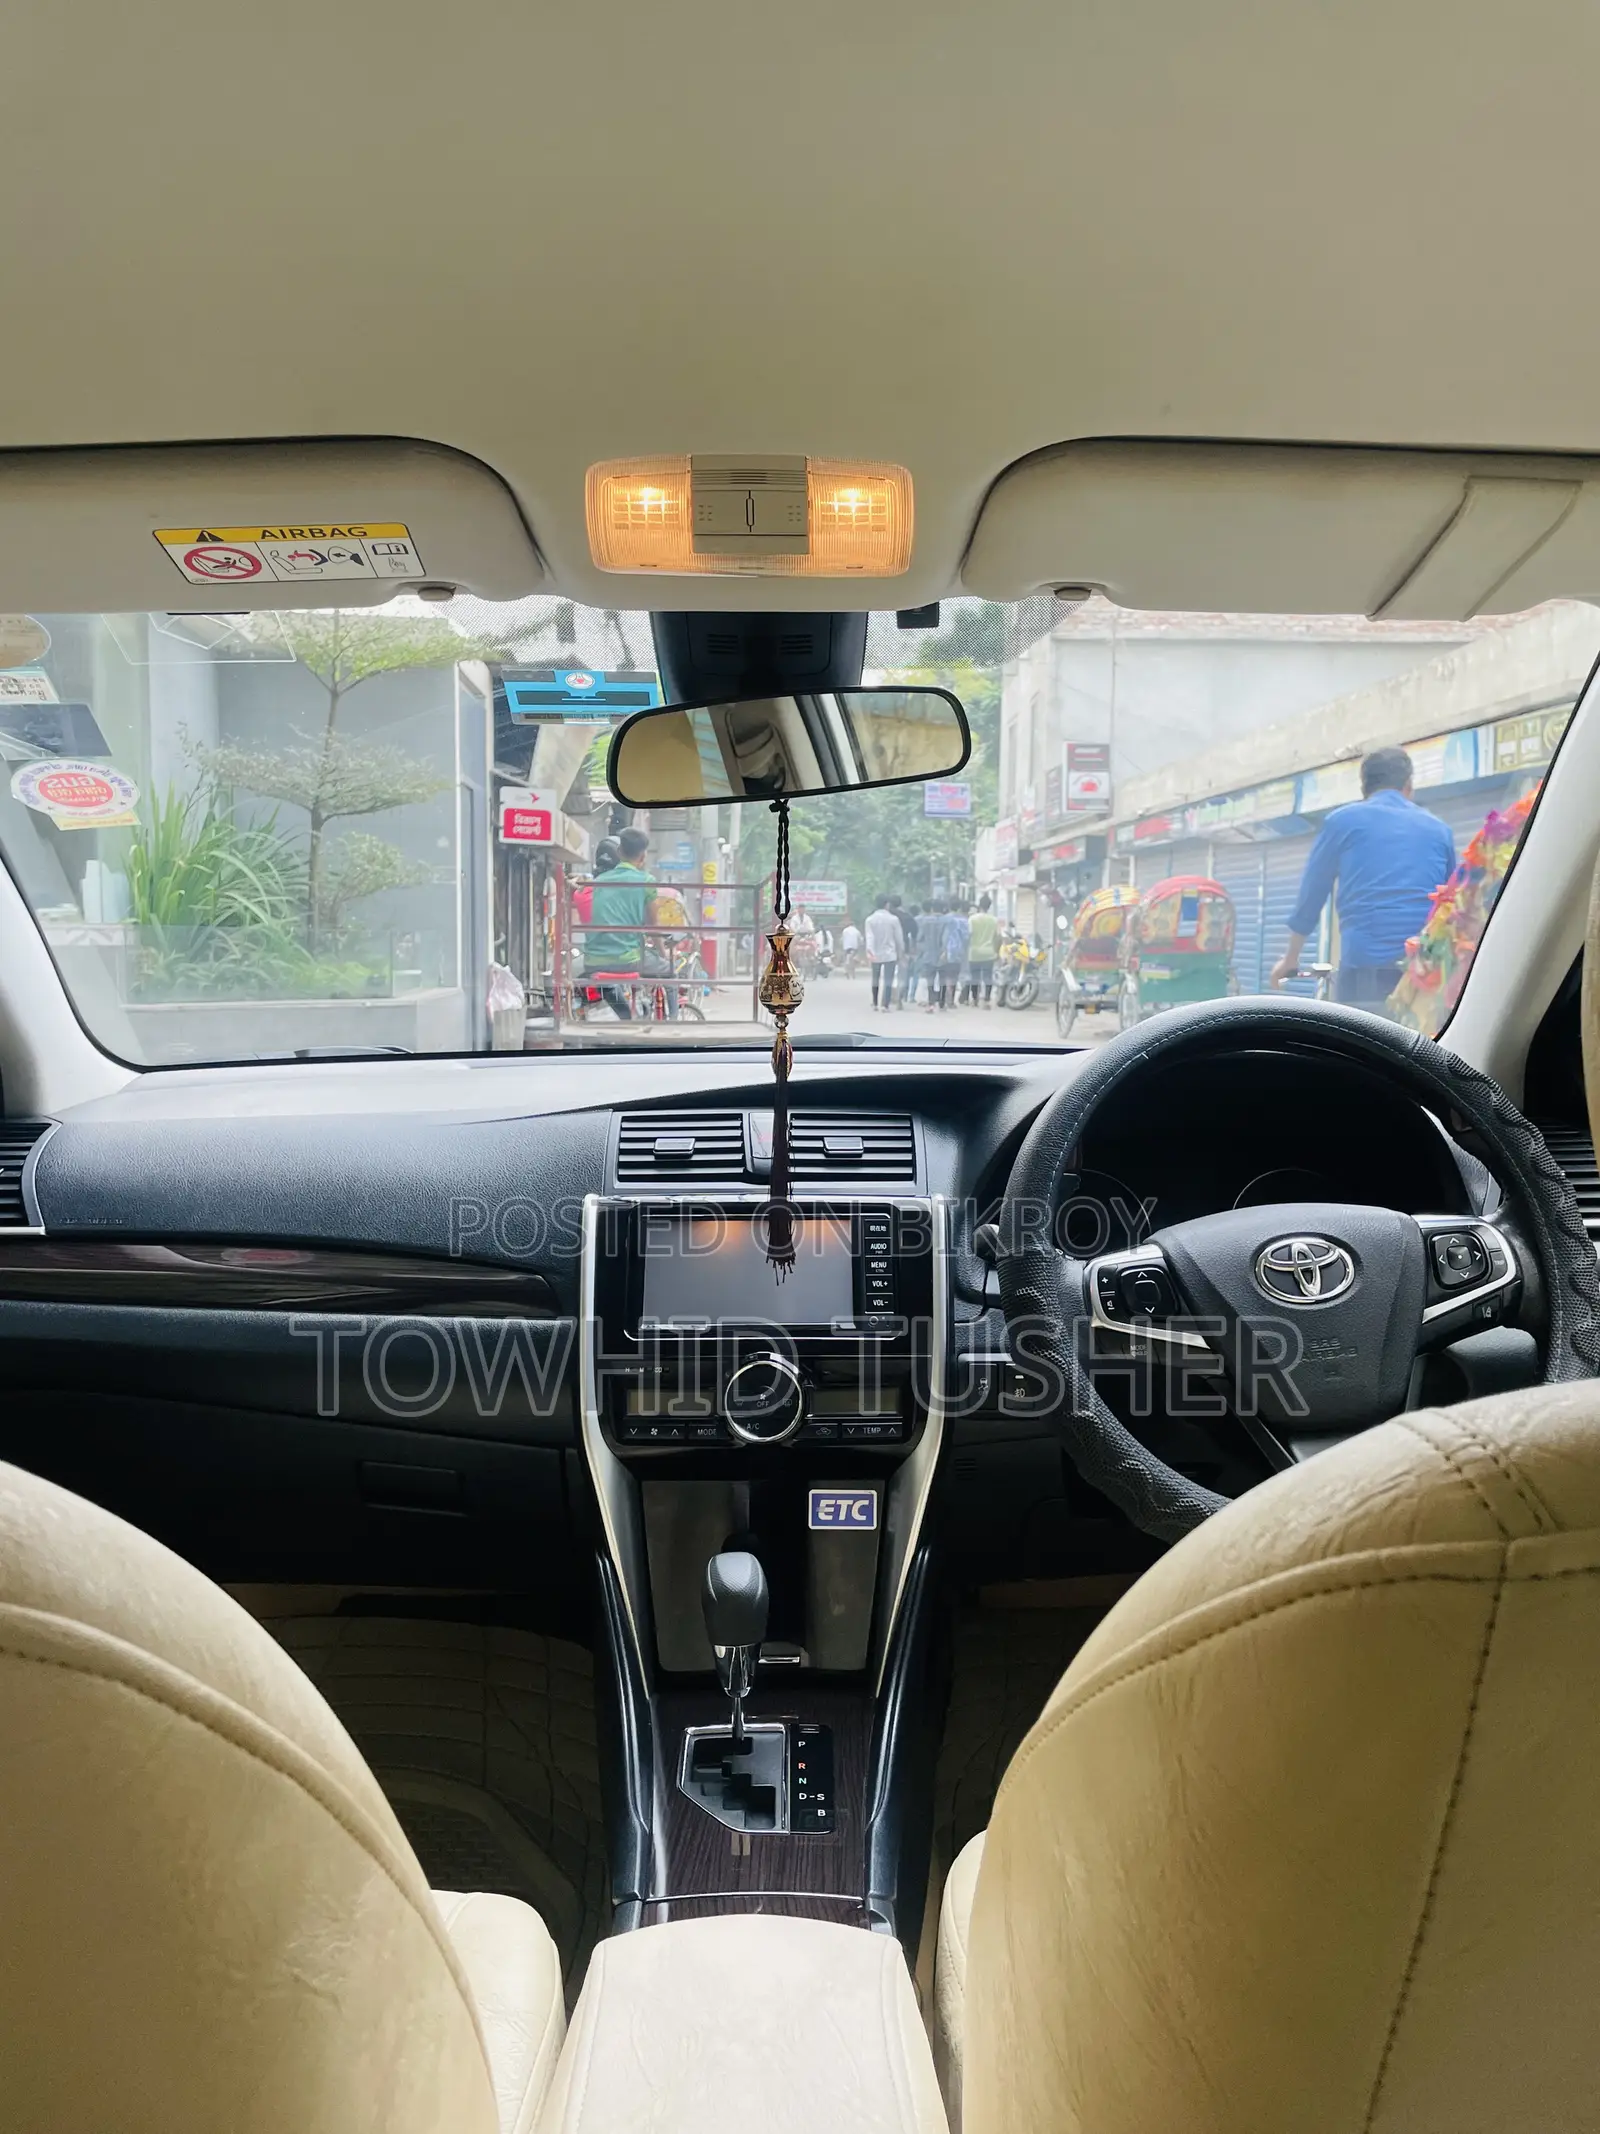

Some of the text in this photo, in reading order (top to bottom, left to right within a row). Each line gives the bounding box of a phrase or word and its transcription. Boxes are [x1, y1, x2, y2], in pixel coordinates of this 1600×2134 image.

[260, 526, 368, 540] AIRBAG
[746, 1423, 760, 1431] A/C
[697, 1428, 718, 1436] MODE
[816, 1499, 870, 1521] ETC
[817, 1809, 826, 1817] B
